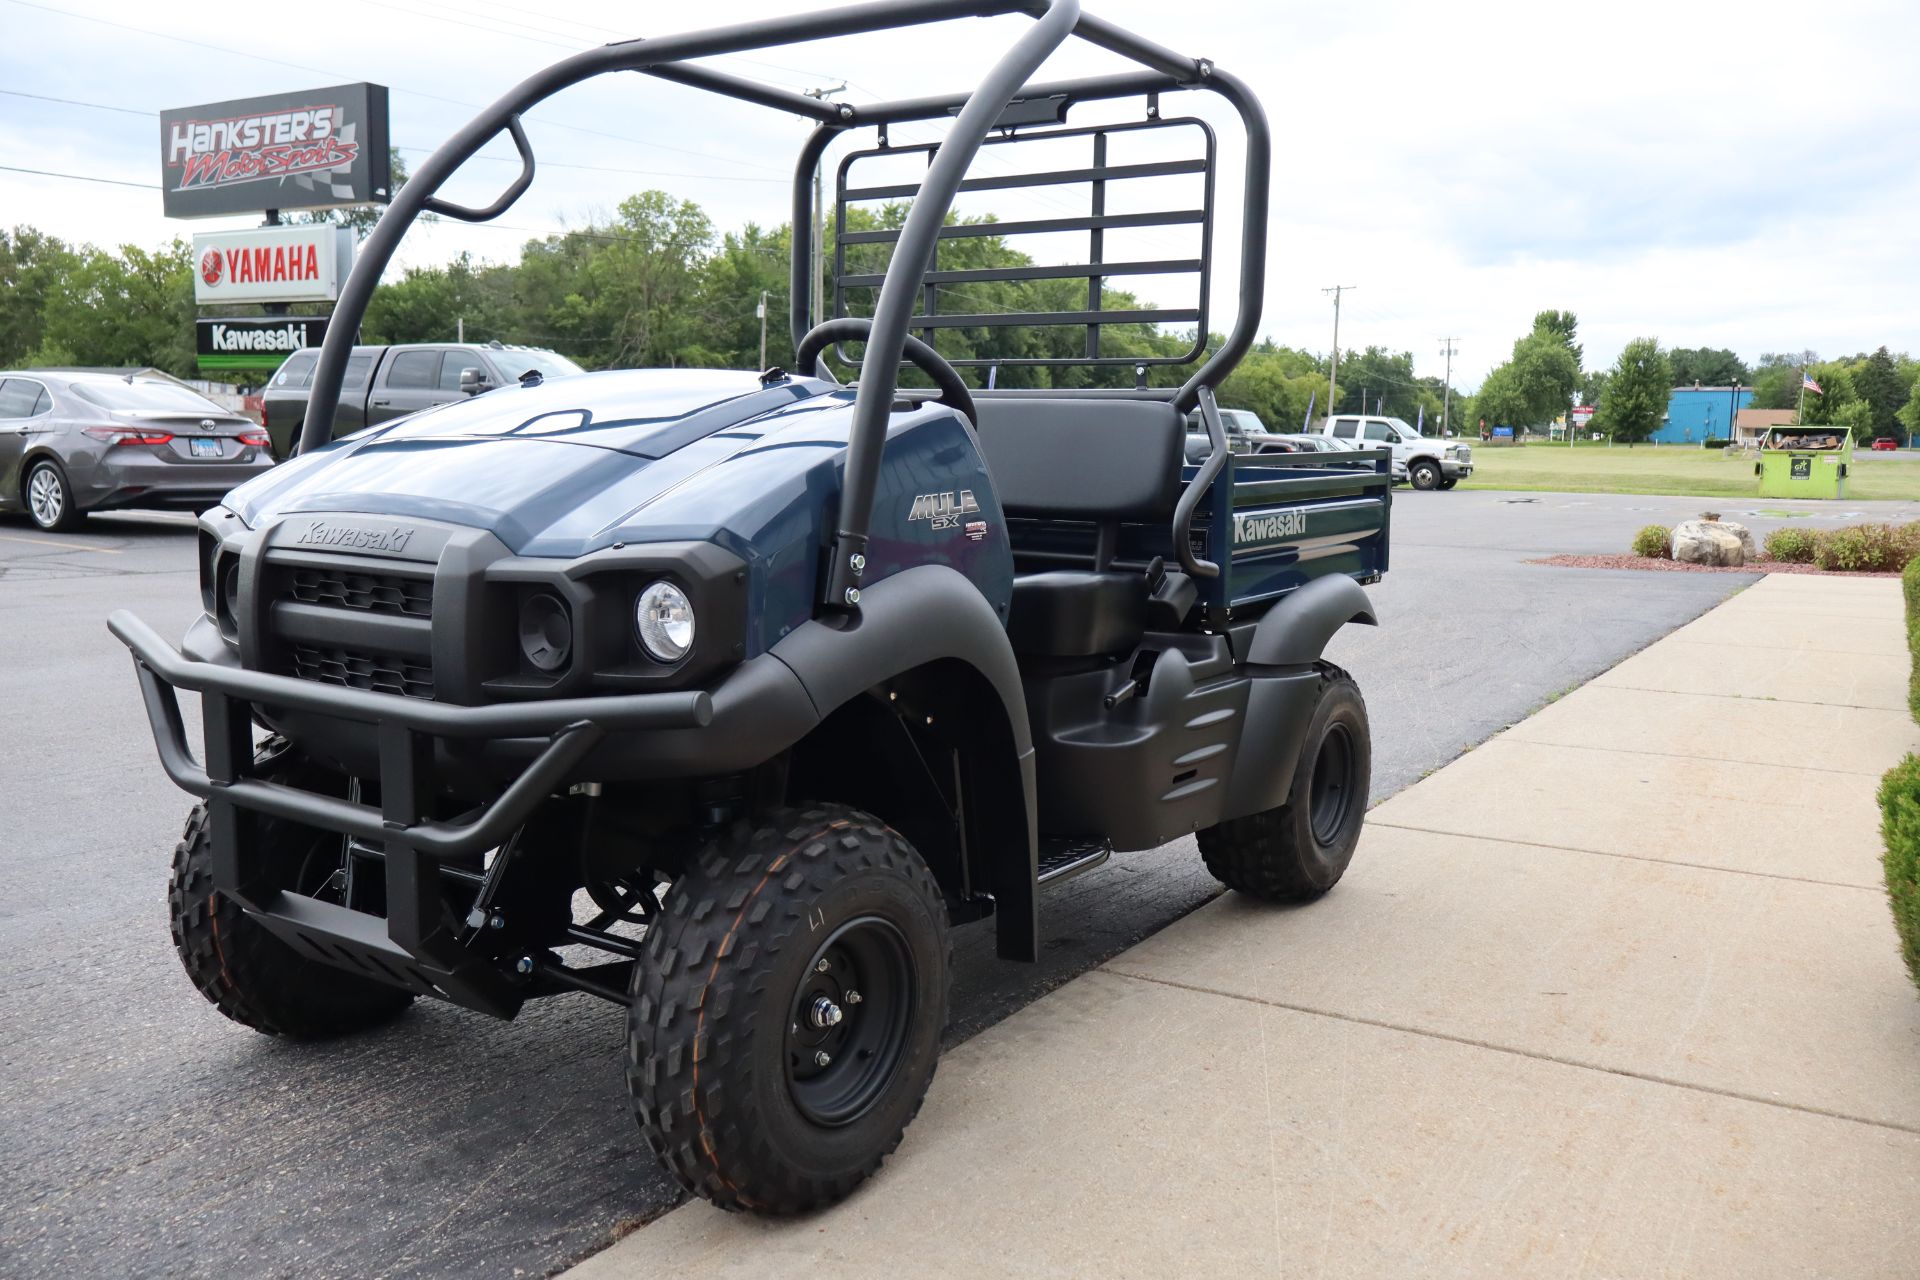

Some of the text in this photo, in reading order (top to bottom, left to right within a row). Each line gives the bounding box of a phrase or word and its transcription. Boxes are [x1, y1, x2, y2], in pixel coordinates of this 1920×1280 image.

[226, 243, 319, 283] YAMAHA
[212, 323, 307, 350] Kawasaki
[908, 489, 981, 521] MULE
[297, 521, 414, 552] Kawasaki
[931, 514, 960, 530] SX
[1233, 508, 1306, 543] Kawasaki
